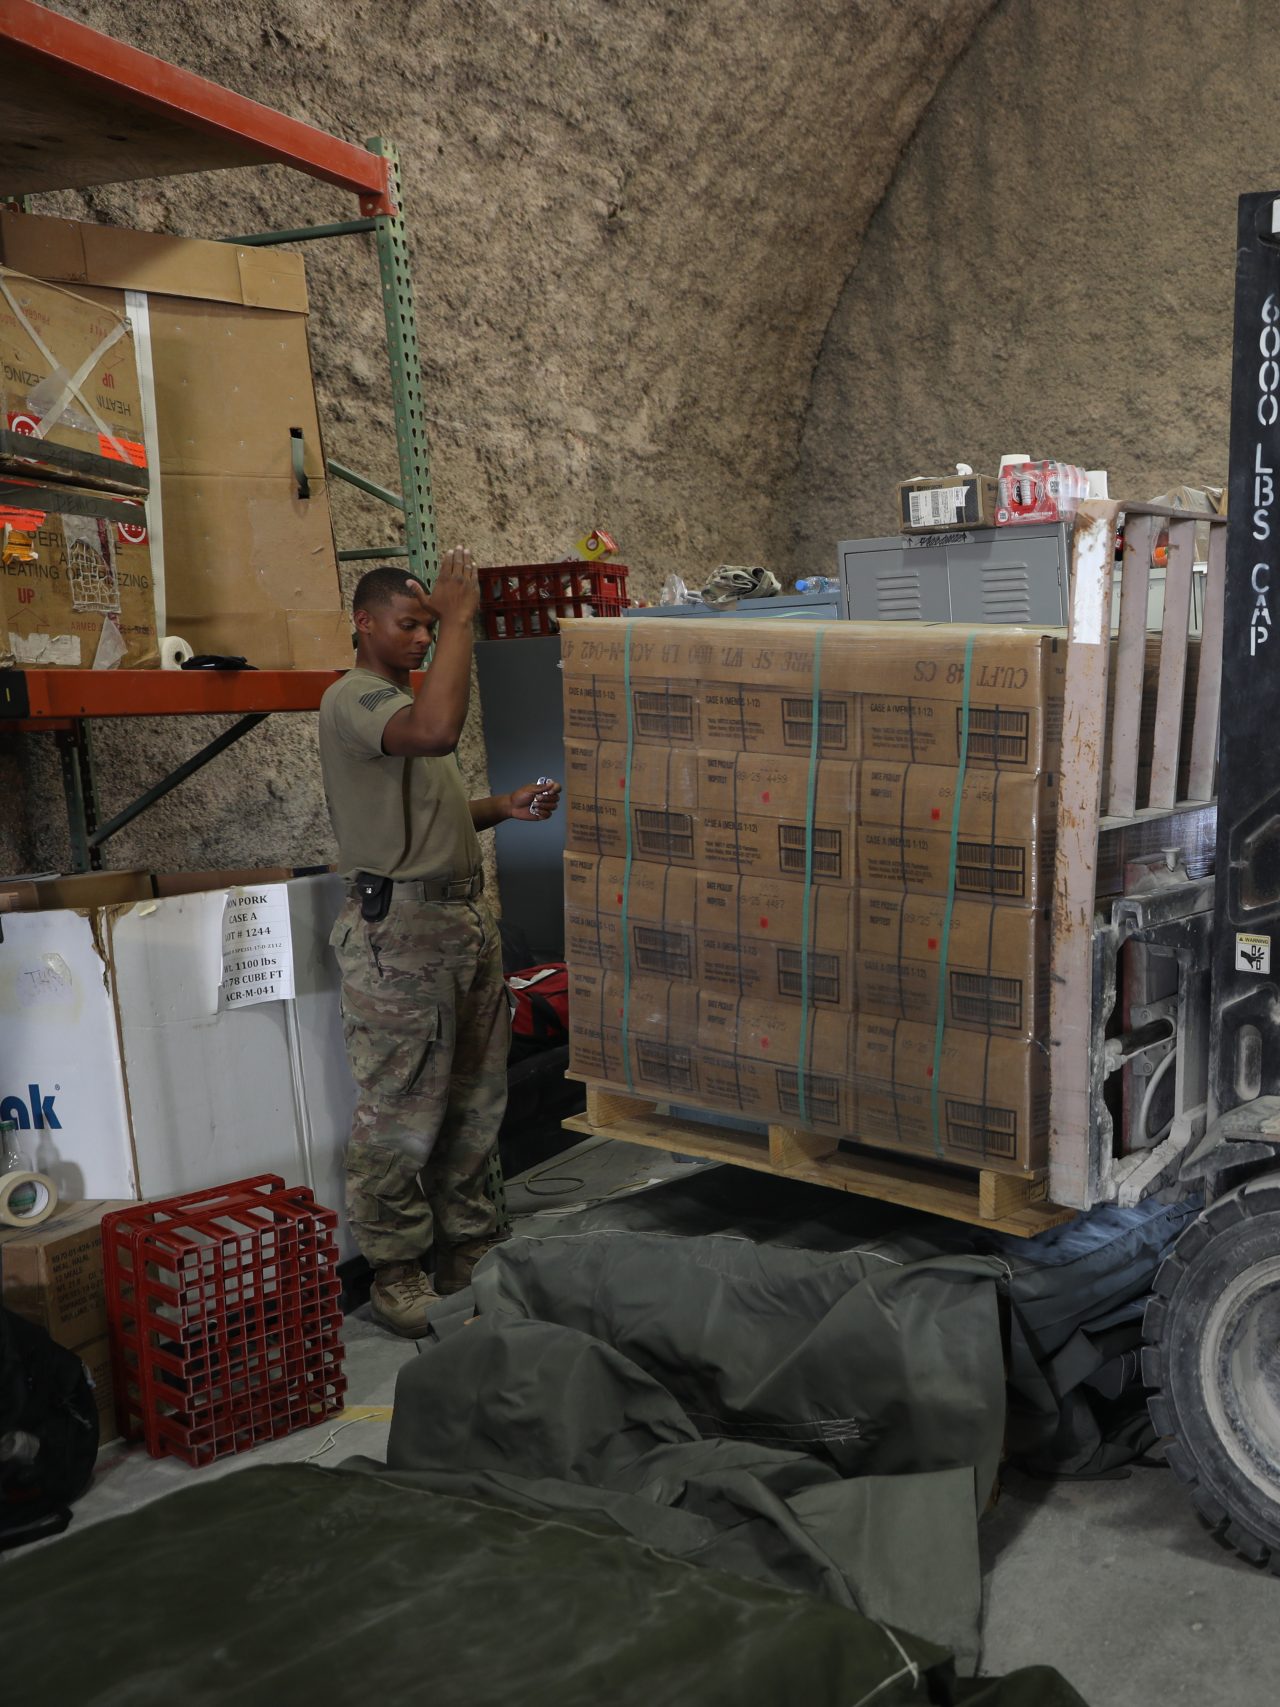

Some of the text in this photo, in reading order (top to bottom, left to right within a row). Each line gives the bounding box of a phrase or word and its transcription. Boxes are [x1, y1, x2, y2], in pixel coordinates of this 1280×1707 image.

[1250, 293, 1280, 657] 6000 LBS CAP
[18, 588, 35, 603] UP
[238, 894, 269, 906] PORK
[229, 912, 258, 924] CASE A
[245, 926, 272, 938] 1244
[1244, 937, 1269, 945] WARNING
[235, 959, 259, 971] 1100
[261, 957, 277, 967] lbs
[242, 971, 267, 984] CUBE
[270, 969, 284, 980] FT
[226, 984, 275, 1002] ACR-M-041
